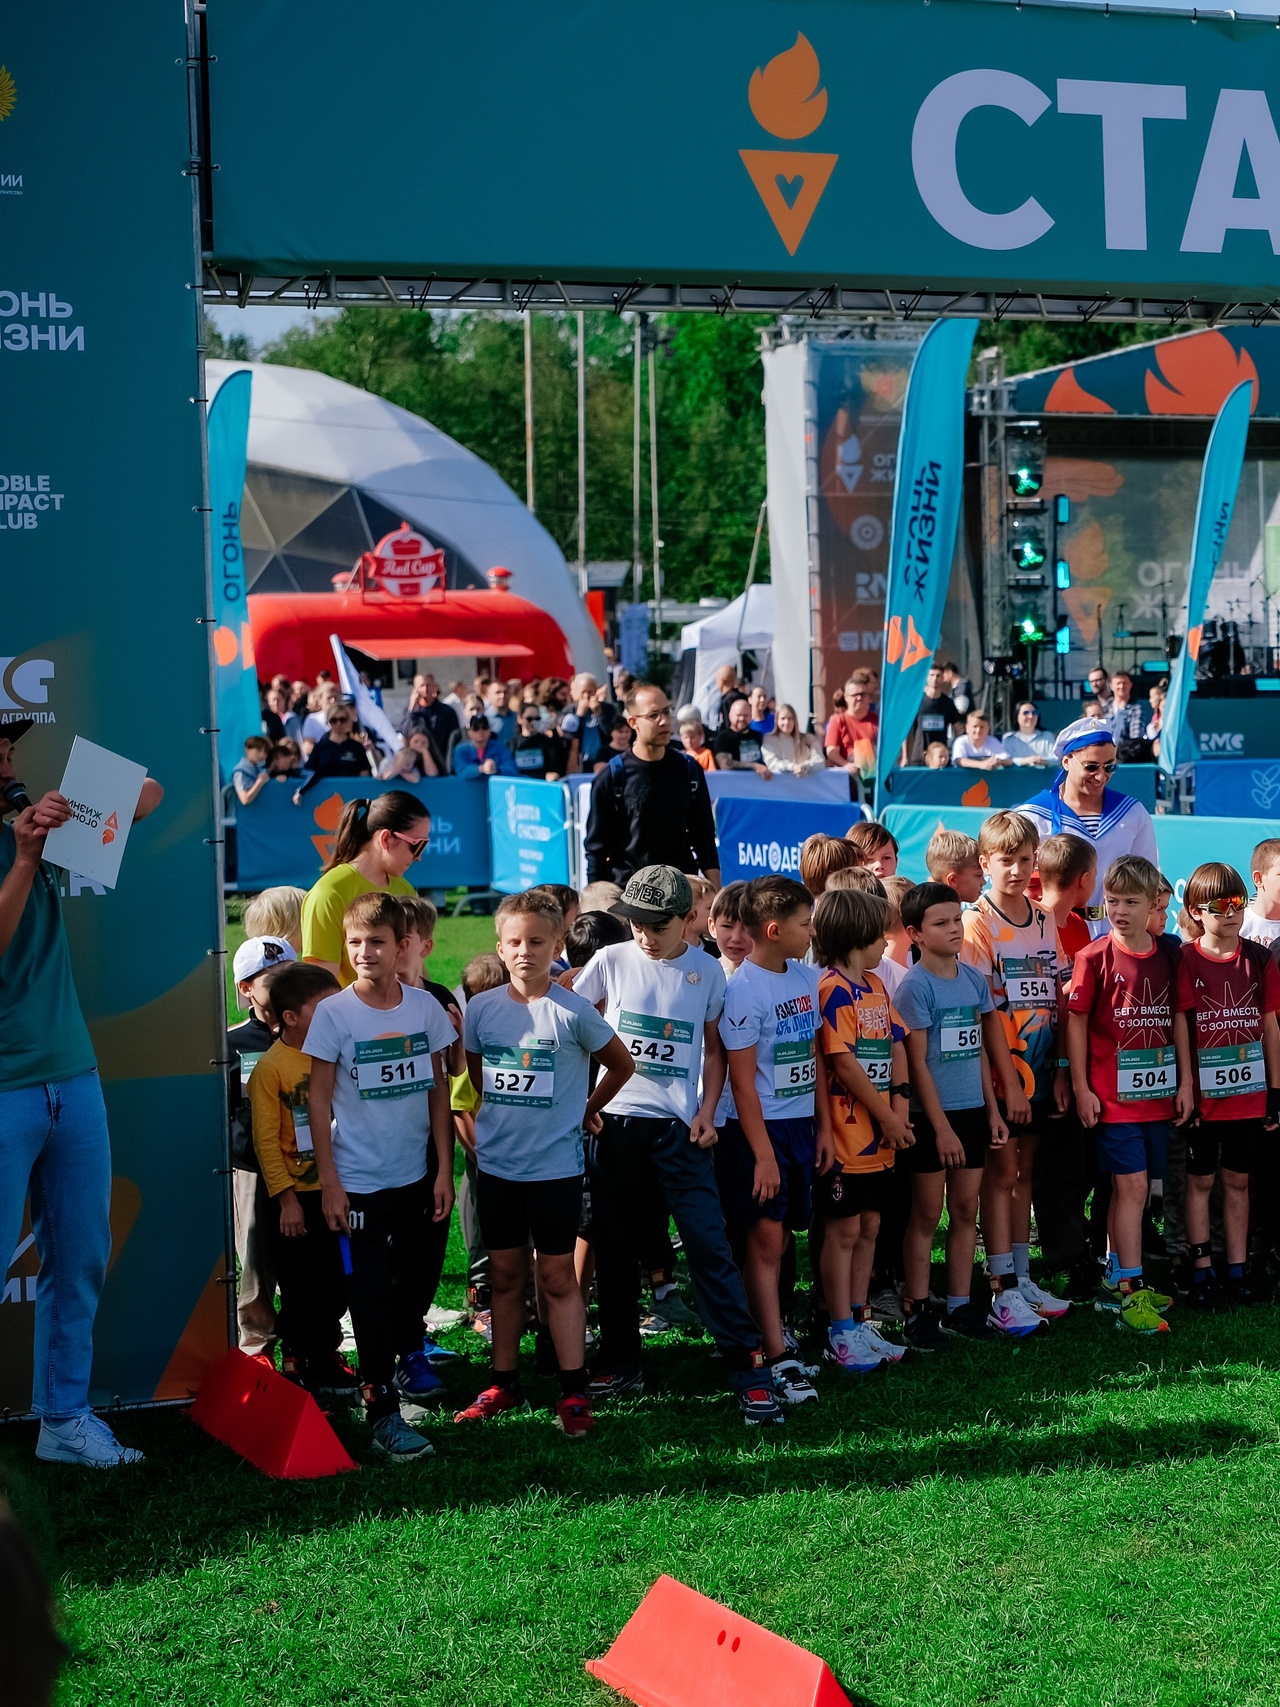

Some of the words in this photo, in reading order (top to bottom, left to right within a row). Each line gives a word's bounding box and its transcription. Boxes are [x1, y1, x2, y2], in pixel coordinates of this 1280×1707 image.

[0, 290, 74, 318] ОНЬ
[0, 323, 85, 351] ЗНИ
[0, 475, 51, 492] OBLE
[0, 494, 65, 511] PACT
[914, 461, 942, 604] ЖИЗНИ
[222, 502, 241, 601] ОГОНЬ
[382, 559, 410, 576] Red
[411, 557, 436, 577] Cup
[1, 711, 57, 725] АГРУППА
[72, 811, 98, 828] ОГОН
[738, 840, 801, 872] БЛАГОДЕ
[1020, 981, 1049, 997] 554
[1114, 1007, 1139, 1017] БЕГУ
[1141, 1006, 1170, 1015] ВМЕСТ
[1196, 1010, 1221, 1021] БЕГУ
[1223, 1007, 1260, 1017] ВМЕСТЕ
[1119, 1020, 1125, 1028] С
[1200, 1024, 1207, 1032] С
[1209, 1019, 1259, 1031] ЗОЛОТЫМ
[629, 1039, 675, 1062] 542
[380, 1061, 416, 1084] 511
[494, 1072, 536, 1092] 527
[790, 1061, 816, 1084] 556
[1132, 1070, 1168, 1089] 504
[1215, 1066, 1252, 1086] 506
